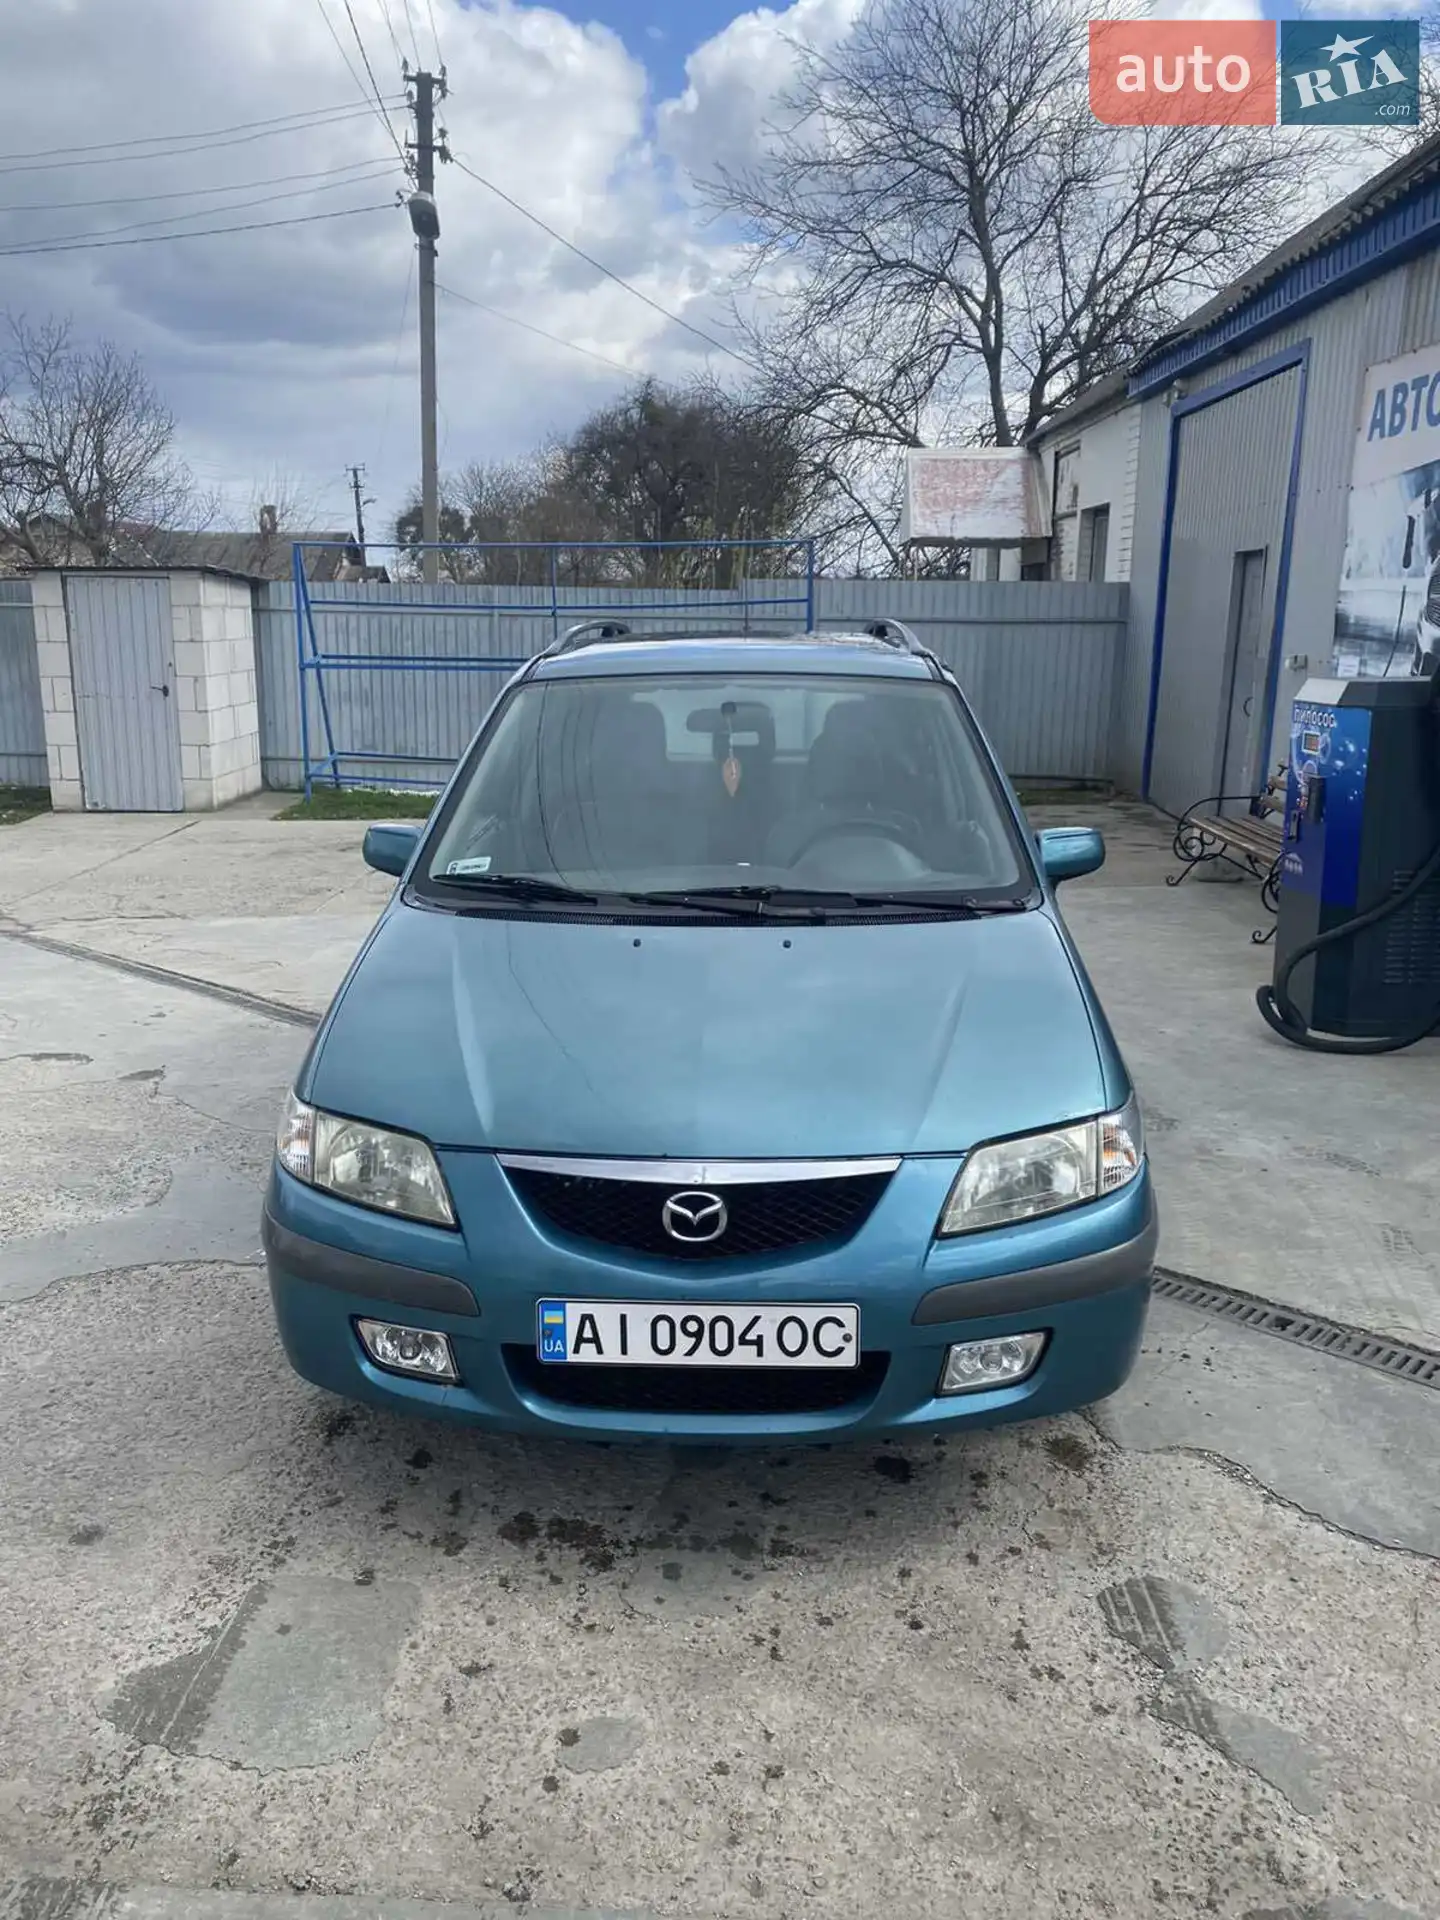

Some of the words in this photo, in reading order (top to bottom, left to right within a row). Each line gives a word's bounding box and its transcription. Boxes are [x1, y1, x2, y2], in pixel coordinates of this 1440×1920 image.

[544, 1339, 564, 1353] UA
[572, 1313, 628, 1355] AI
[650, 1314, 764, 1358] 0904
[776, 1315, 847, 1358] OC
